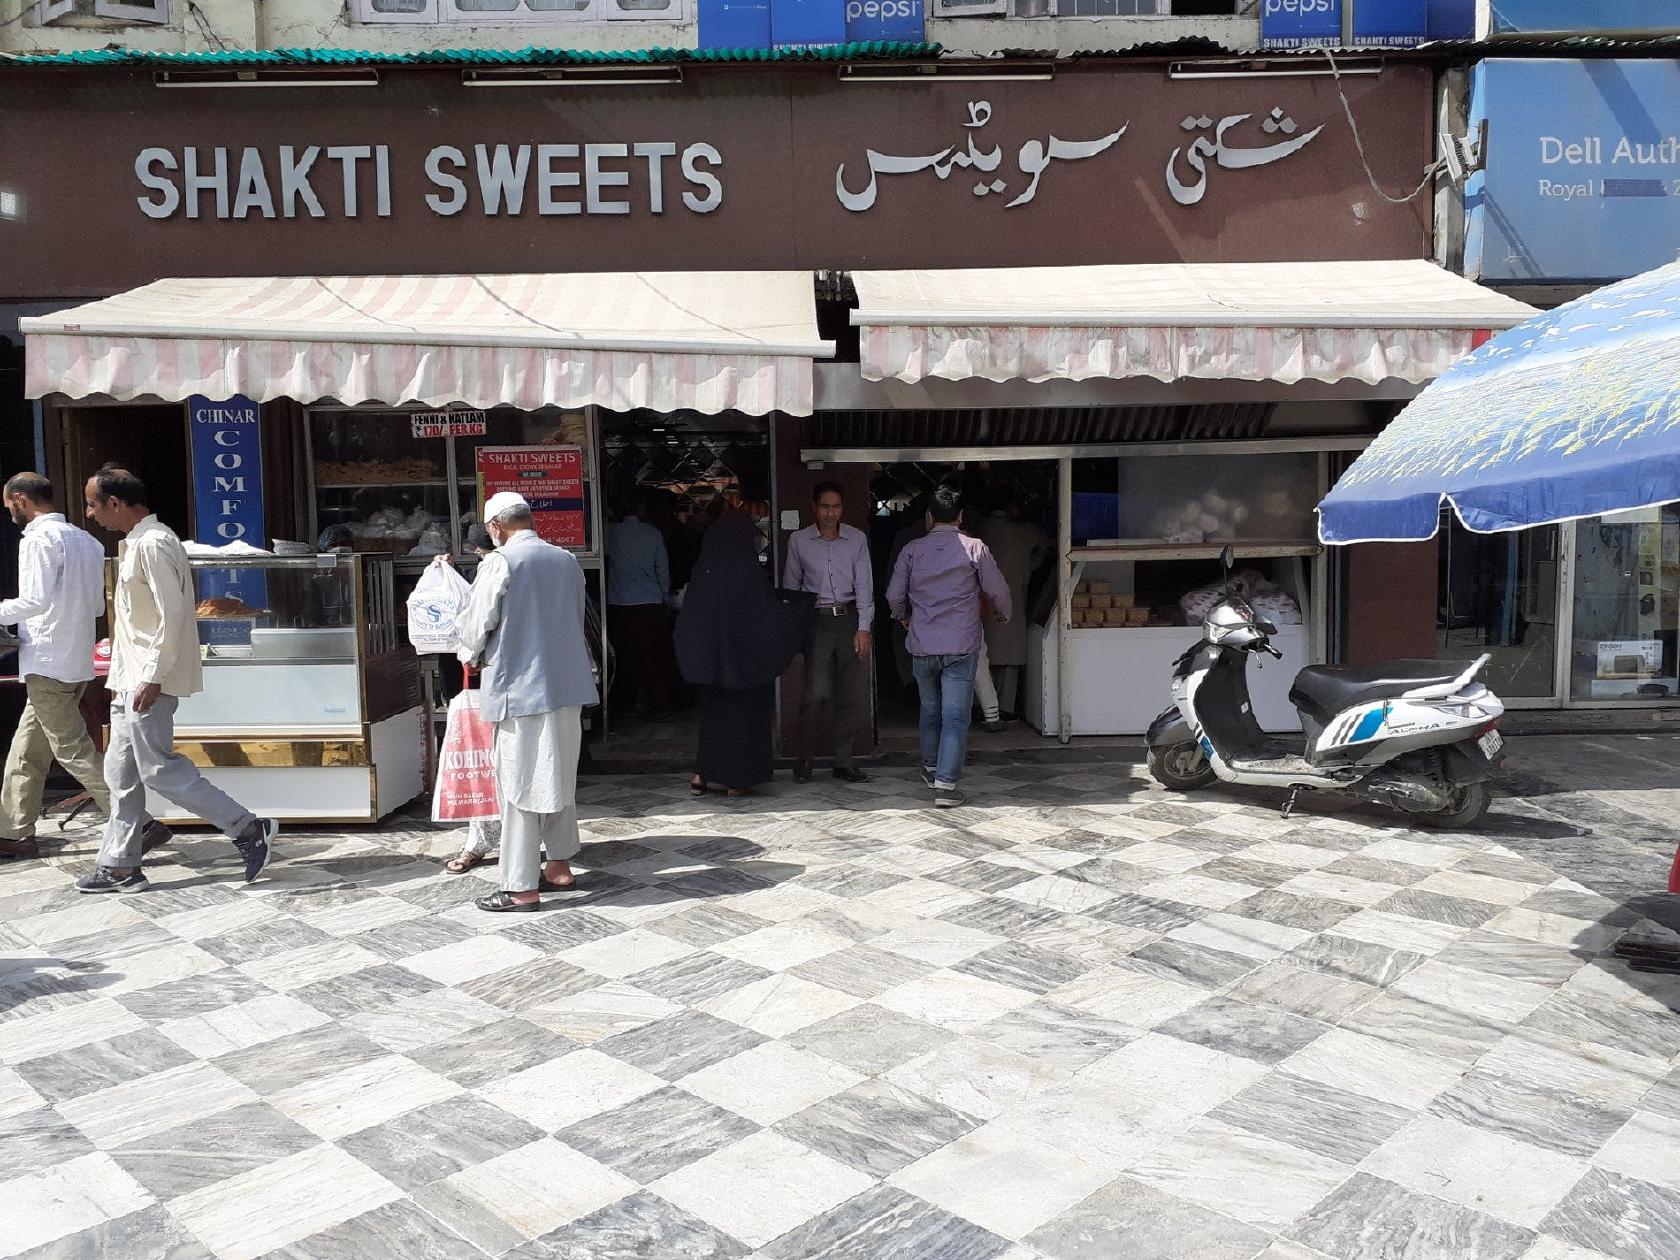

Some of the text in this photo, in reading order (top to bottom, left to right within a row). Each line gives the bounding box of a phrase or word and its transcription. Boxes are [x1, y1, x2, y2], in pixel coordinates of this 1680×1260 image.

[846, 0, 917, 23] pepsi
[1263, 36, 1341, 48] SHAKTI SWEETS
[1353, 36, 1425, 47] SHAKTI SWEETS
[1538, 136, 1602, 165] Dell
[134, 141, 723, 219] SHAKTI SWEETS
[1537, 179, 1594, 202] Royal
[196, 409, 256, 424] CHINAR
[488, 453, 529, 464] SHAKTI
[530, 451, 577, 463] SWEETS
